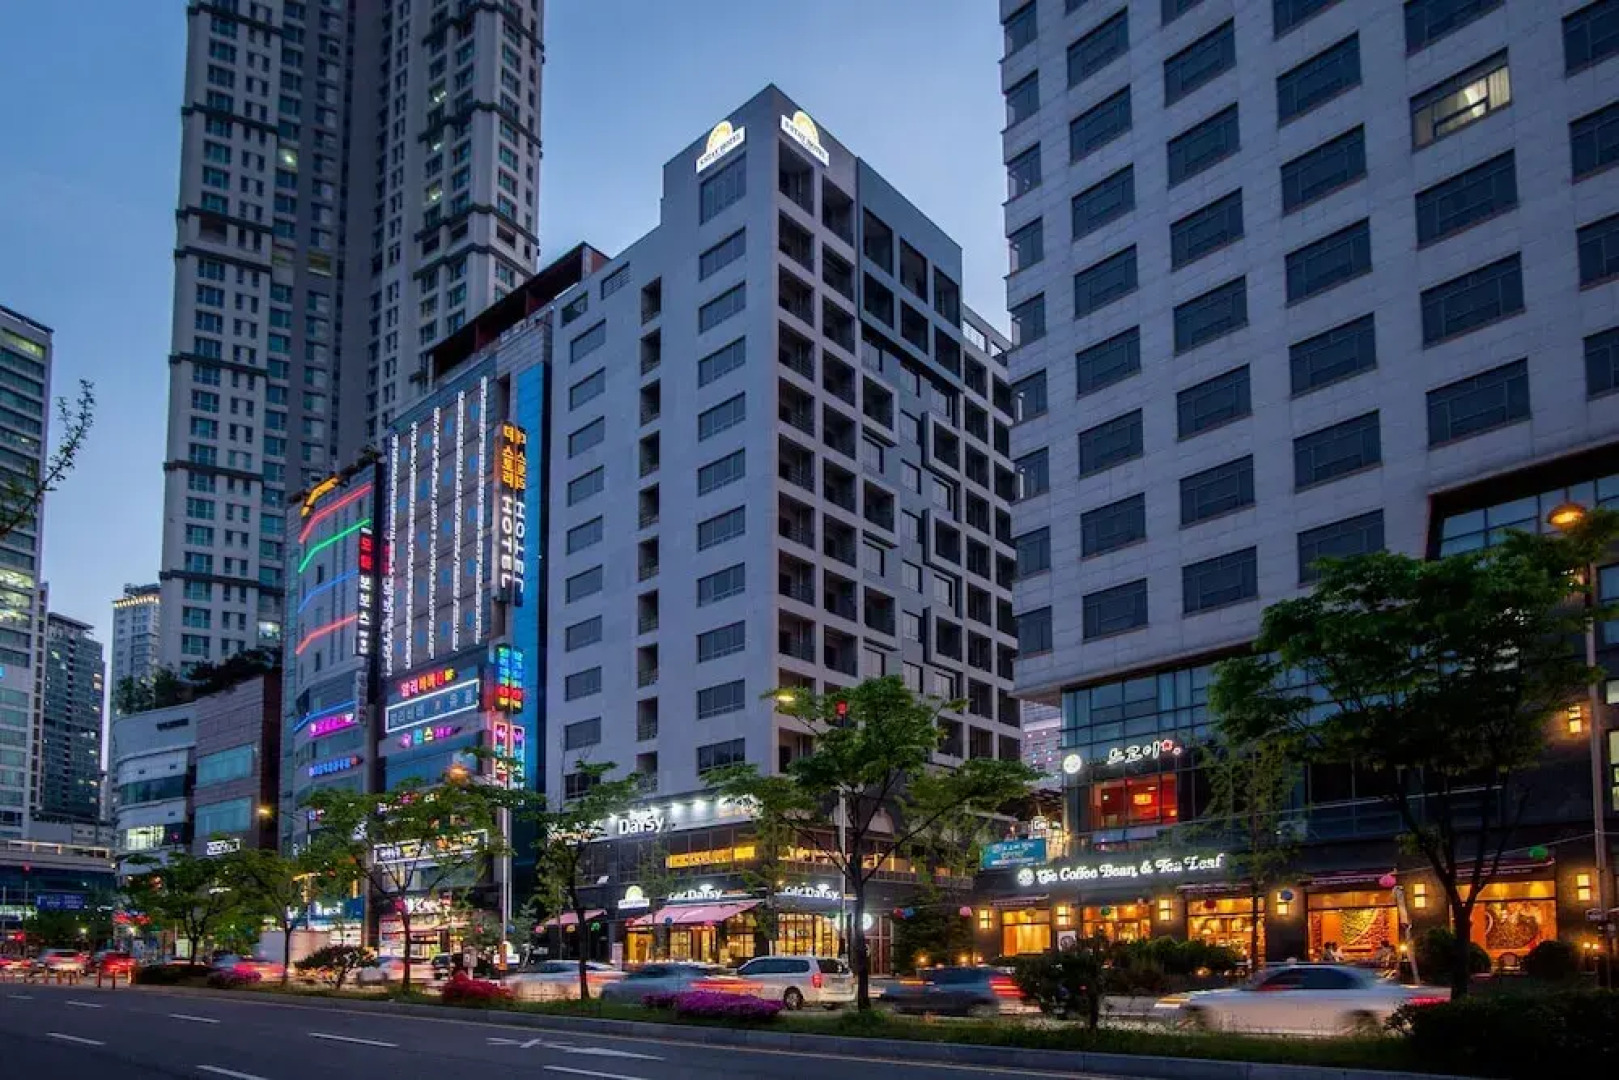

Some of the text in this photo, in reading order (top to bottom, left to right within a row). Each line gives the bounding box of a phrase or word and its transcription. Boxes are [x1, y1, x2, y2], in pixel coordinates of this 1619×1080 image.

[501, 496, 513, 588] HOTEL
[1060, 867, 1097, 881] Coffee
[1099, 864, 1138, 879] Bean
[1140, 860, 1153, 874] &
